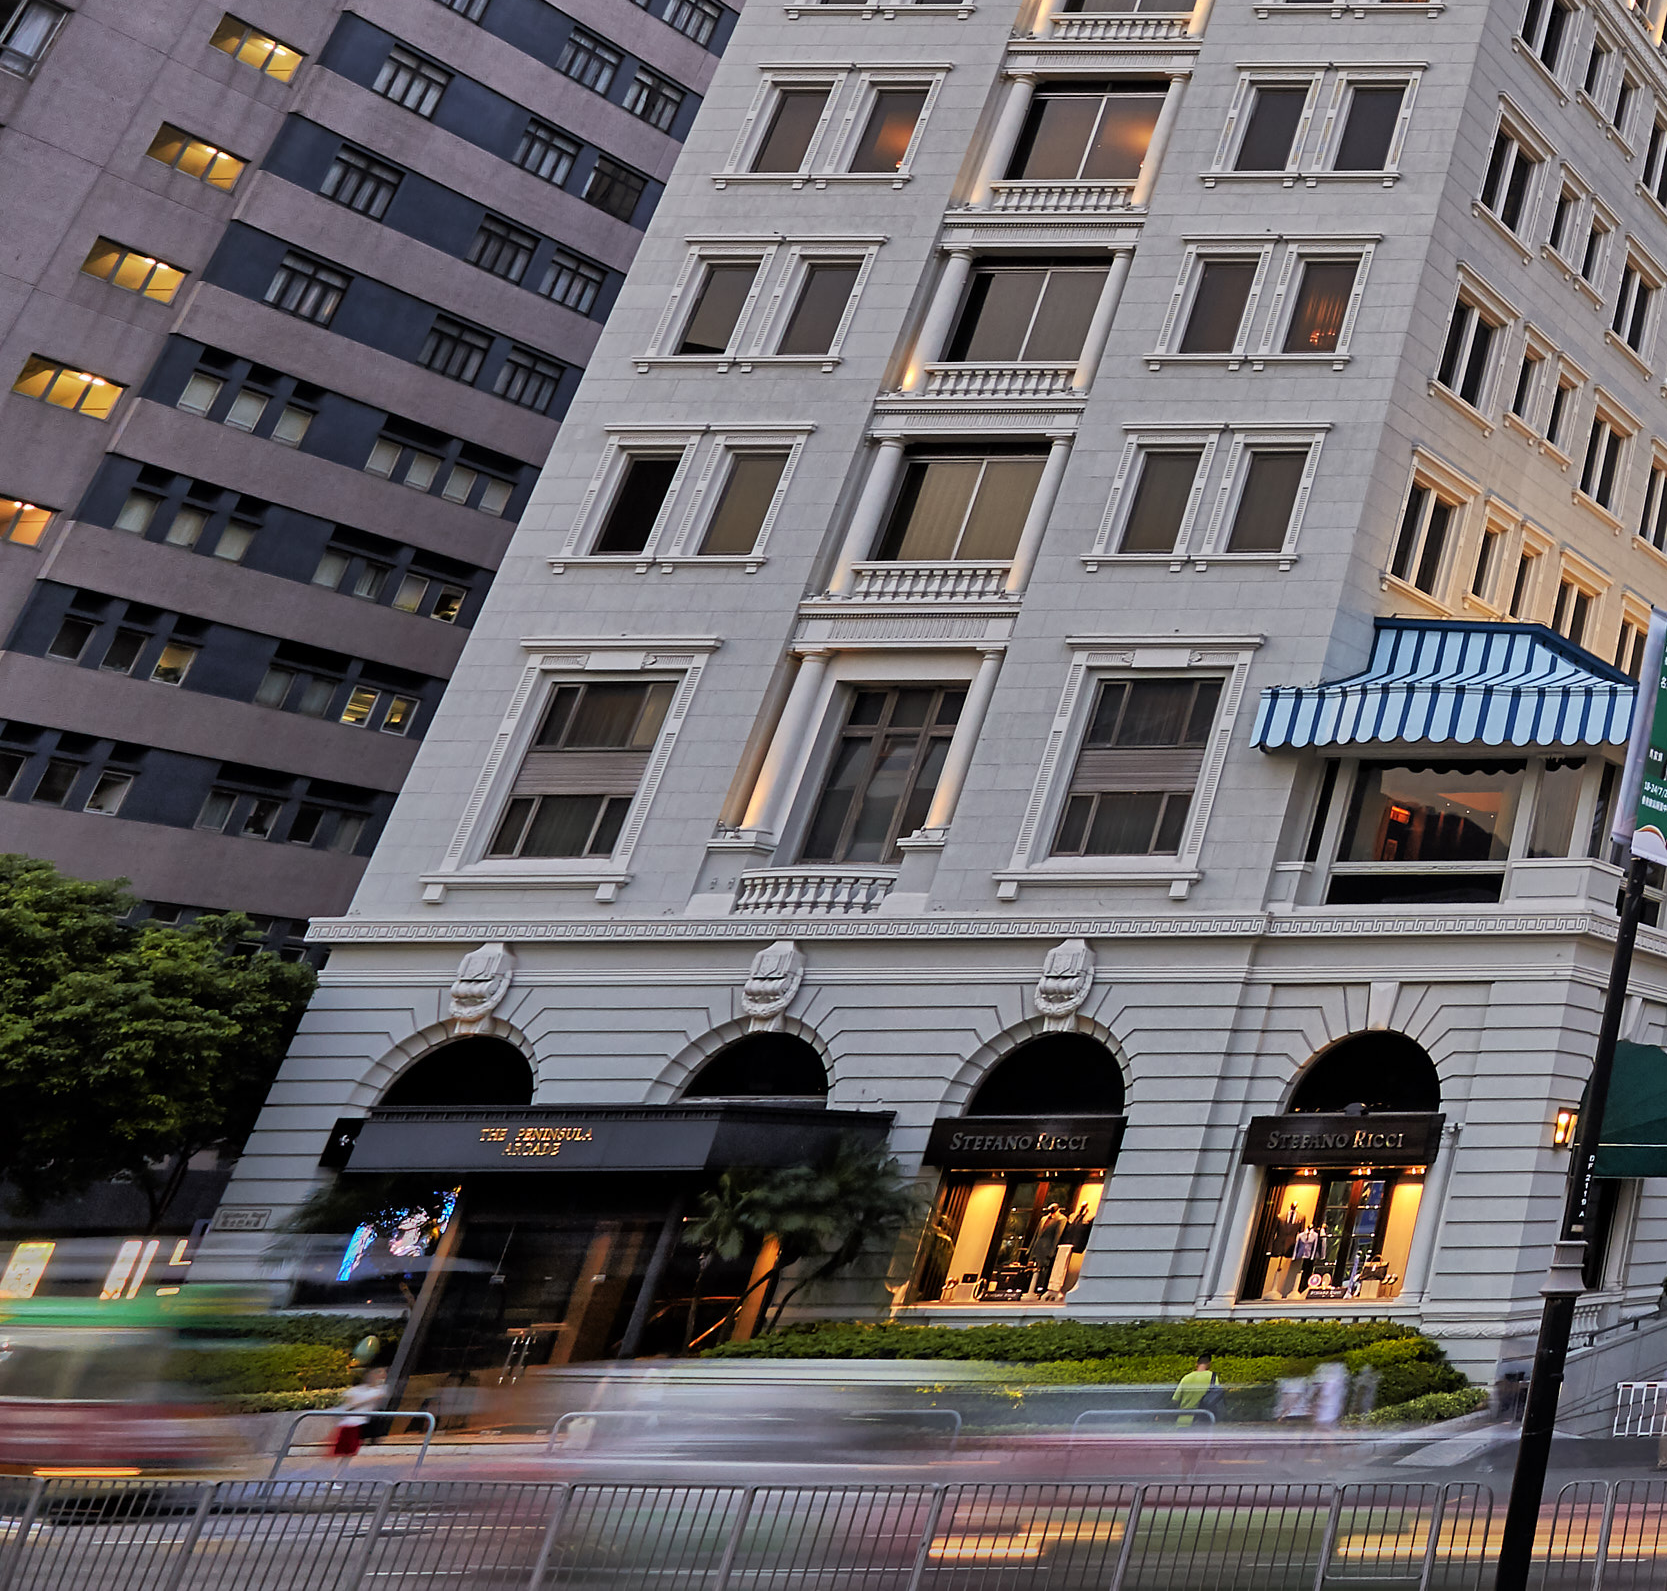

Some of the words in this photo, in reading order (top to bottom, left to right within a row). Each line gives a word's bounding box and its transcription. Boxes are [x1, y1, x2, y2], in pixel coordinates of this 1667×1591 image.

[480, 1128, 508, 1141] THE
[515, 1127, 593, 1141] PENINSULA
[949, 1132, 1034, 1151] STEFANO
[1034, 1132, 1090, 1151] RICCI
[1266, 1130, 1350, 1150] STEFANO
[1352, 1130, 1406, 1149] RICCI
[501, 1142, 562, 1156] ARCADE
